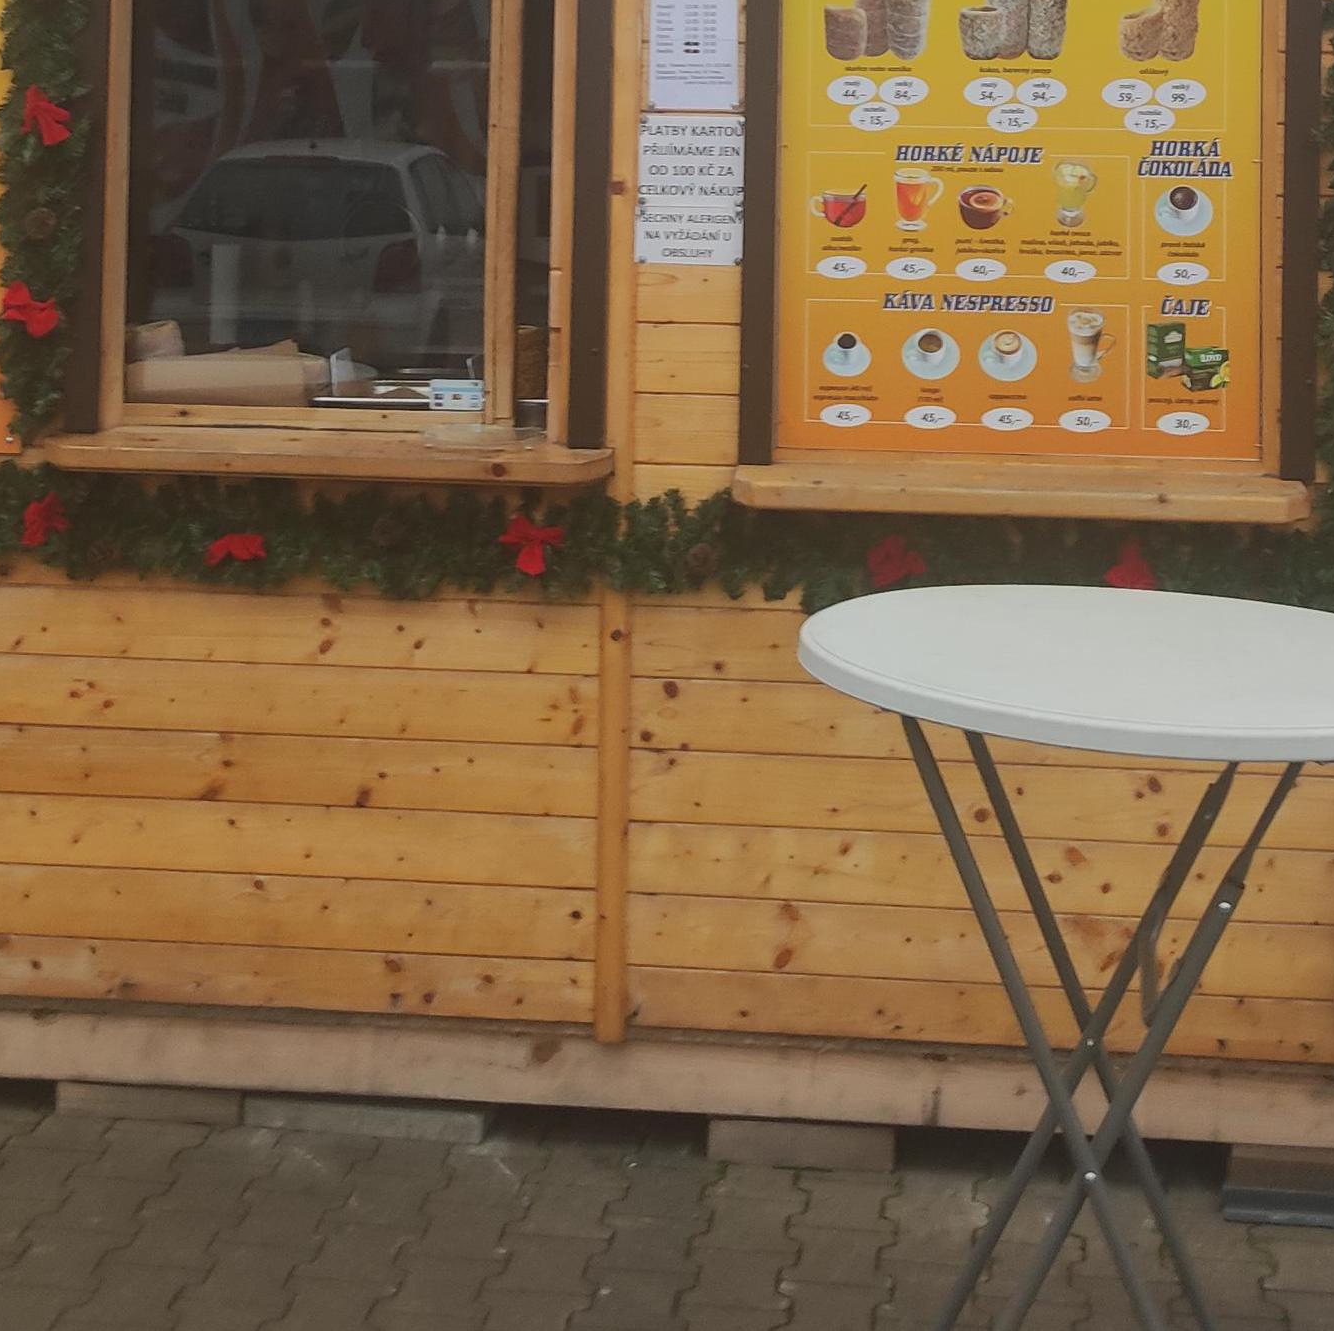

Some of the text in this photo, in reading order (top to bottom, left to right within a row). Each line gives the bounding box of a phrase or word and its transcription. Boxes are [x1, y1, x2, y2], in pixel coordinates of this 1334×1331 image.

[640, 124, 744, 137] PLATBY KARTOU
[718, 146, 741, 157] JEN
[895, 143, 1044, 164] HORKÉ NÁPOJE
[1150, 137, 1221, 157] HORKÁ
[648, 165, 669, 176] OD
[717, 165, 735, 177] ZA
[1137, 156, 1233, 177] ČOKOLÁDA
[638, 183, 744, 197] CELKOVÝ NÁKUP
[644, 230, 660, 240] NA
[883, 289, 1054, 313] KÁVA NESPRESSO
[1161, 295, 1211, 316] ČAJE
